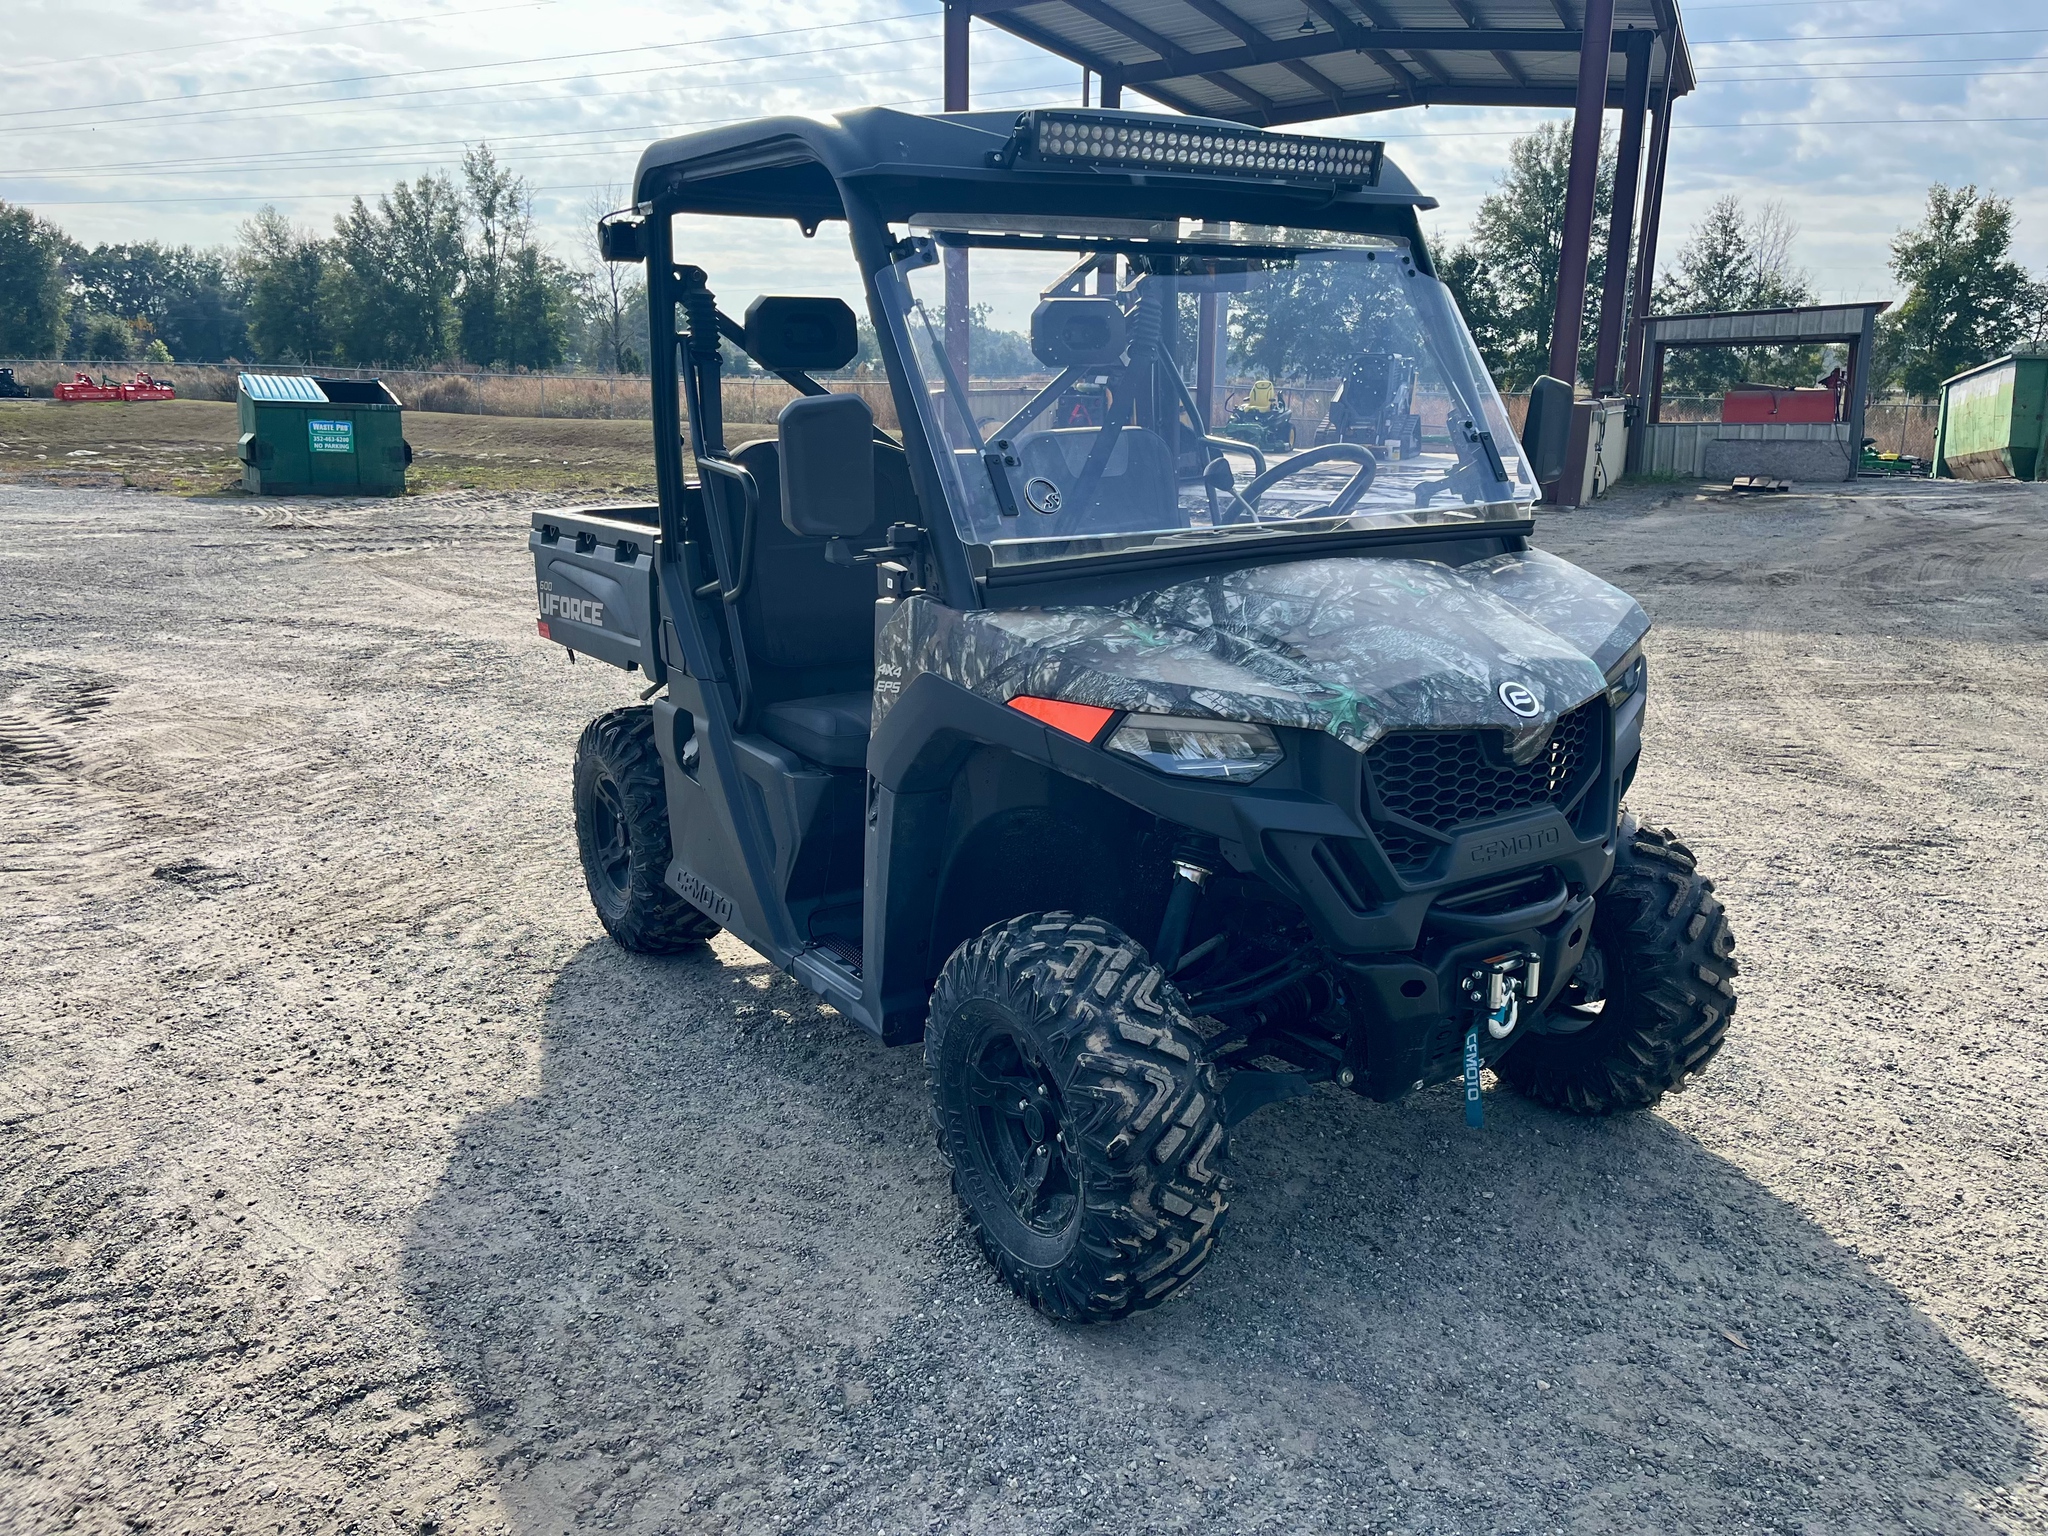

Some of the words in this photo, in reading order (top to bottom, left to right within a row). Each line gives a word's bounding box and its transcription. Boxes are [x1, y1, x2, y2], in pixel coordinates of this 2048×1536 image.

[539, 580, 553, 592] 600
[539, 592, 604, 627] UFORCE
[876, 680, 902, 694] EPS
[877, 663, 902, 678] 4X4
[1470, 827, 1560, 862] CFMOTO
[676, 867, 733, 922] CFMOTO
[1465, 1033, 1480, 1101] CFMOTO
